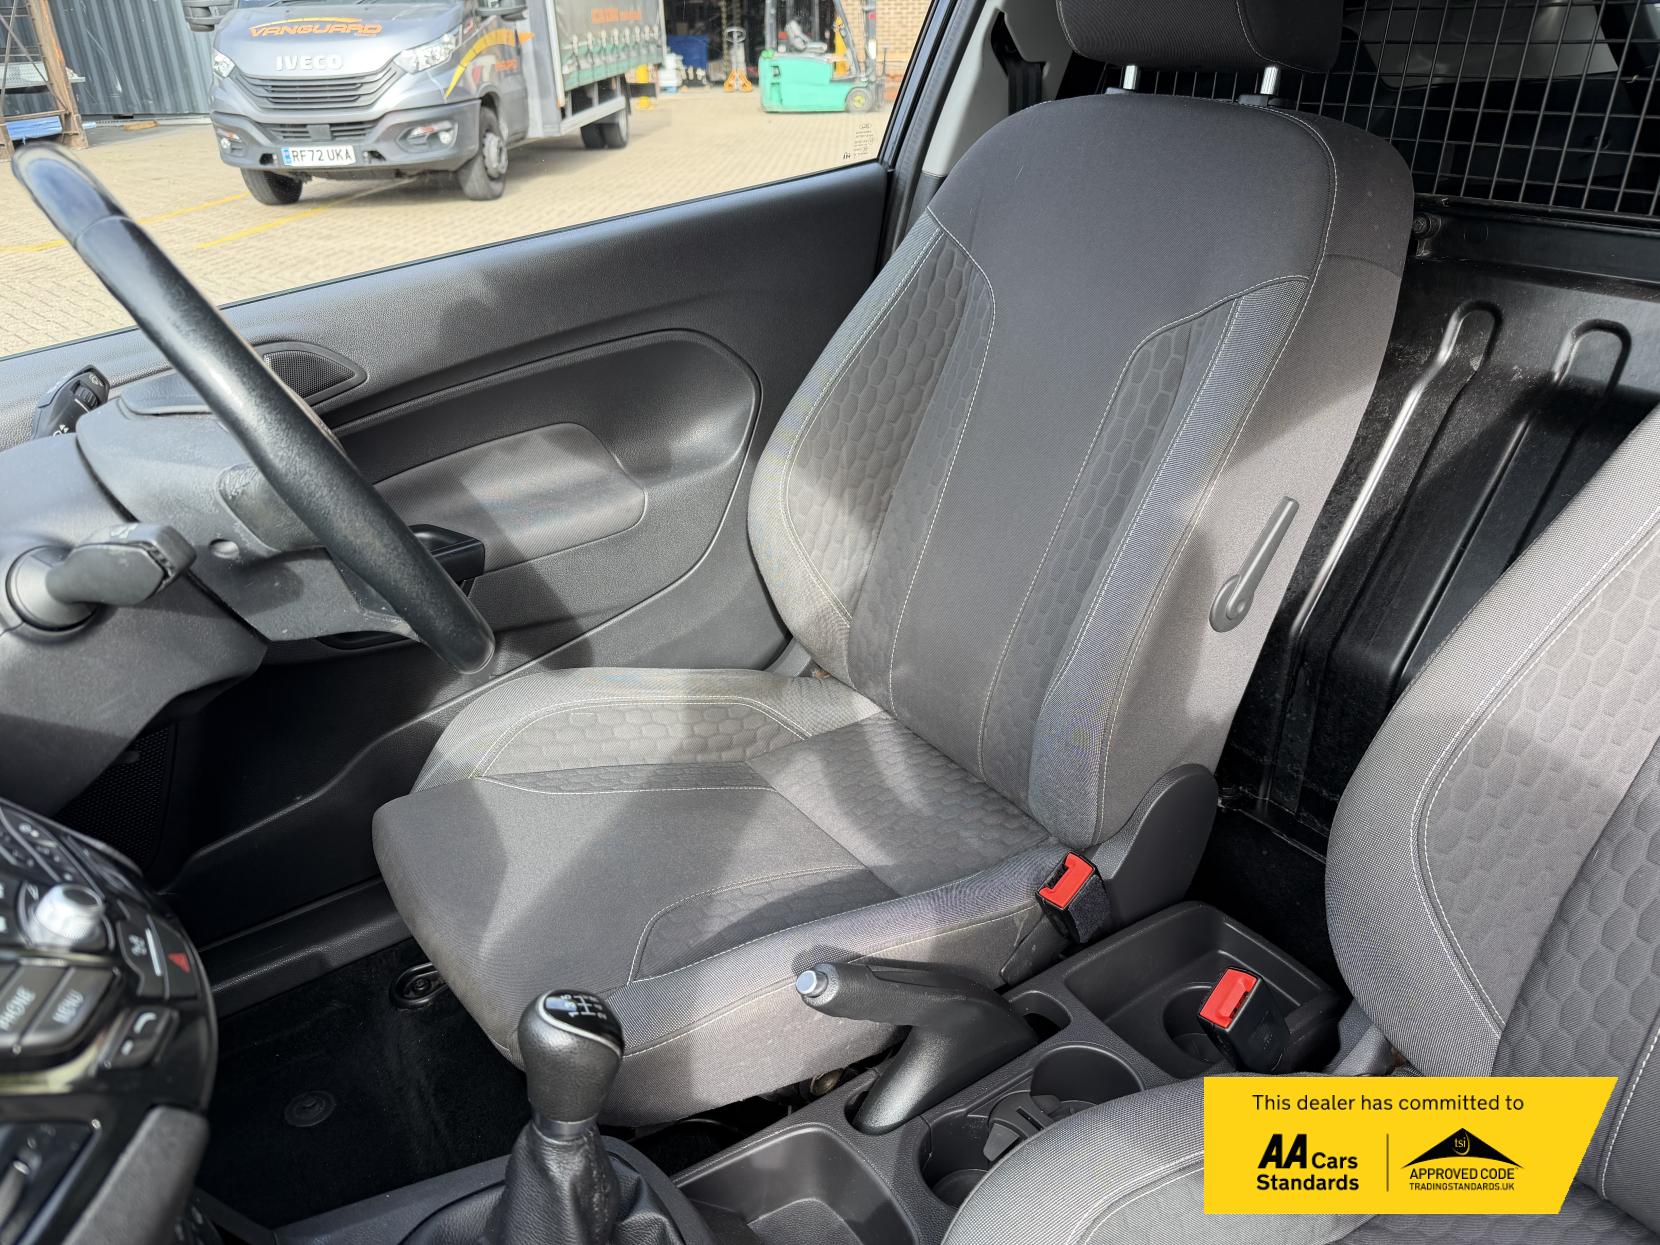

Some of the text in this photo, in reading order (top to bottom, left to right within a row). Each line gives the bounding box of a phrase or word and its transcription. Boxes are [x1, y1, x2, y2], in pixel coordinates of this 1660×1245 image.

[250, 23, 382, 38] VANGUARD
[275, 54, 344, 71] IVECO
[291, 148, 352, 162] RF72 UKA
[53, 989, 84, 1024] MENU
